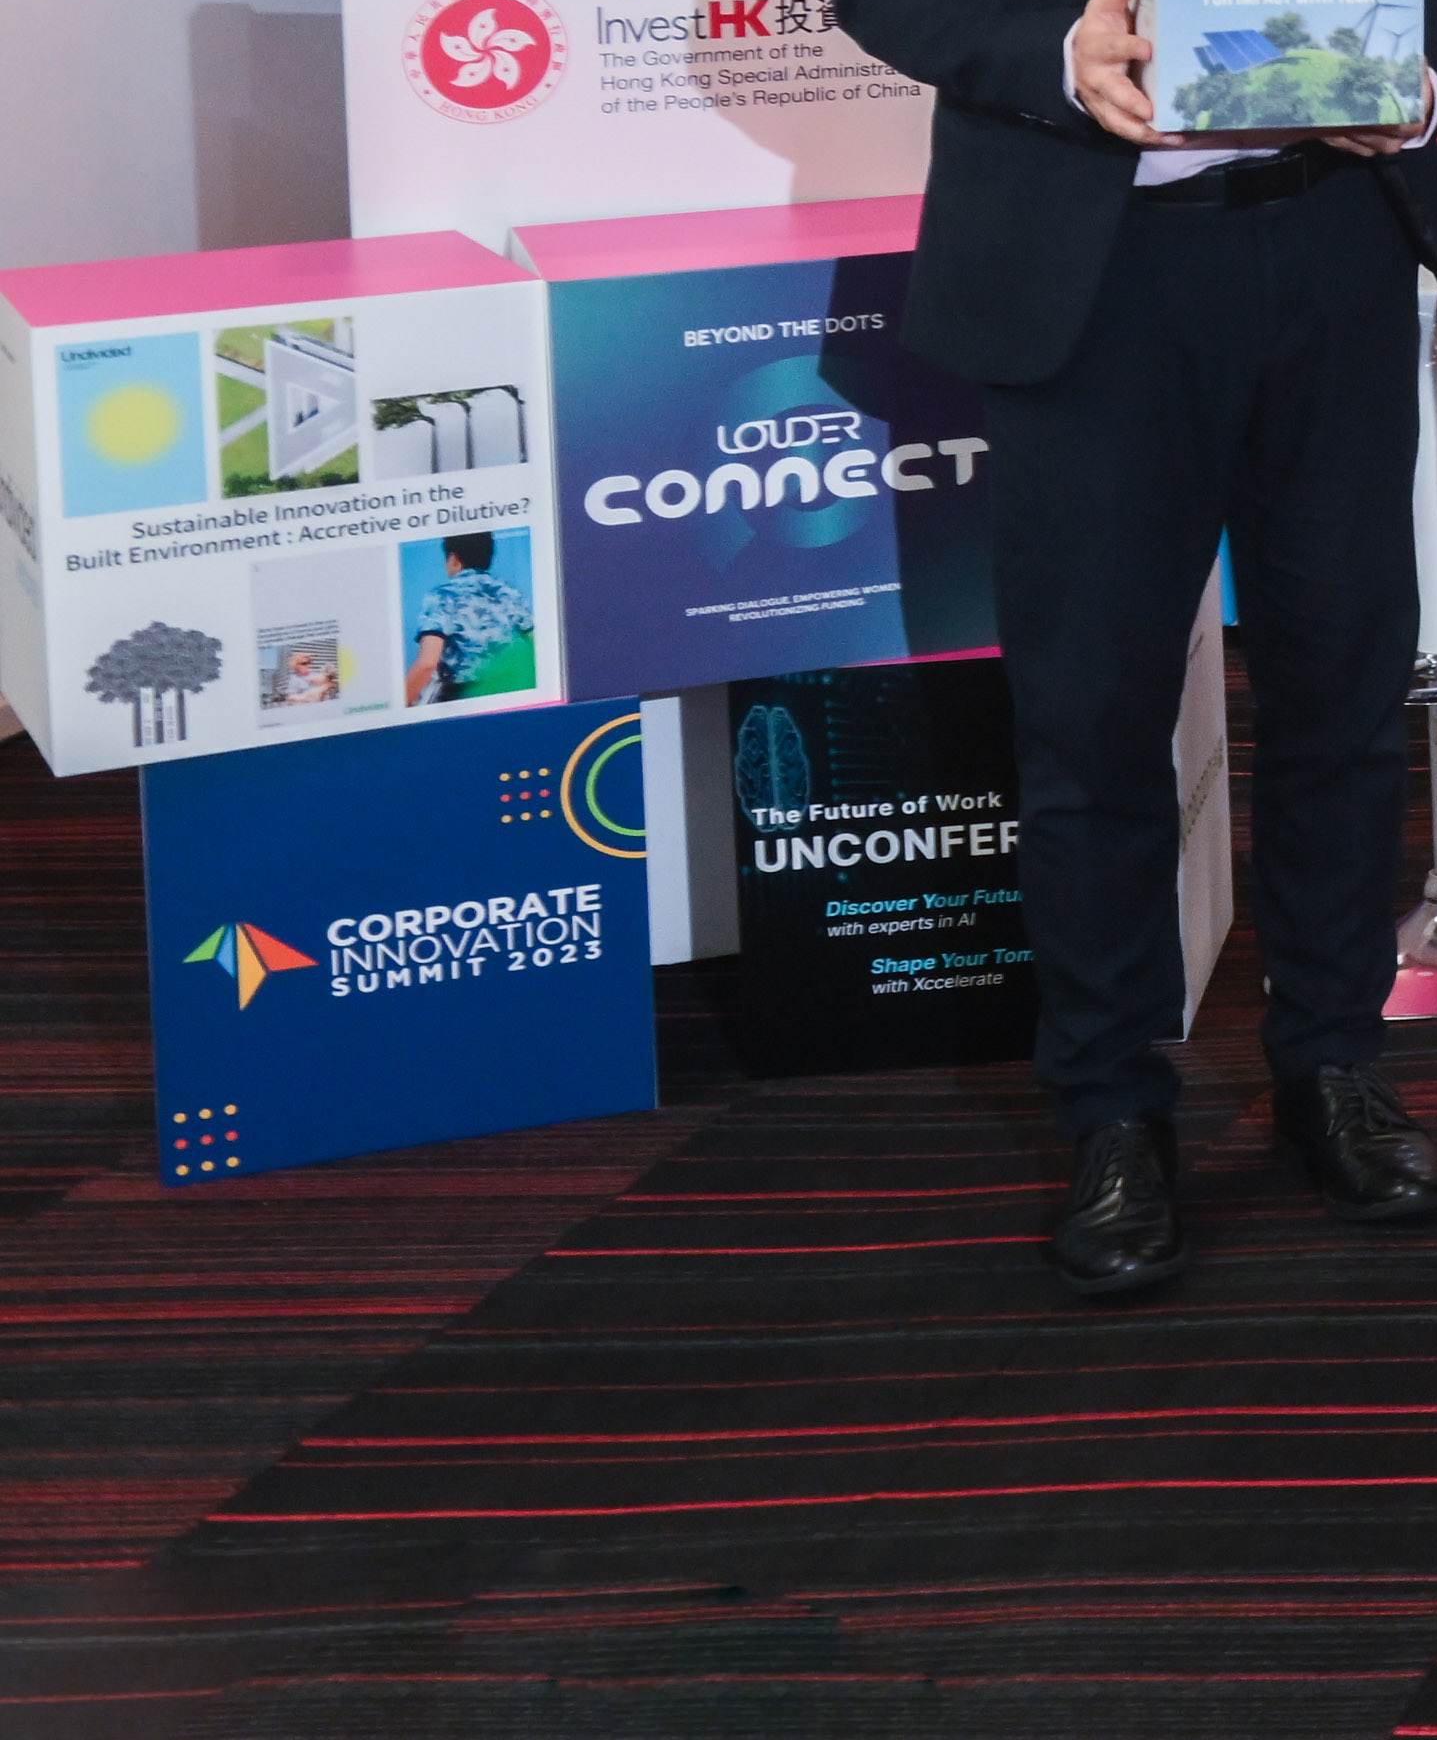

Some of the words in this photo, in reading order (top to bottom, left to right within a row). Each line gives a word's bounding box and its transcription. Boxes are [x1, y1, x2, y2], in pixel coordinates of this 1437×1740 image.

[600, 51, 635, 68] The
[643, 46, 763, 66] Government
[769, 45, 788, 59] of
[793, 44, 823, 58] the
[601, 76, 653, 93] Hong
[661, 73, 711, 90] Kong
[718, 66, 788, 87] Special
[601, 99, 621, 114] of
[627, 97, 657, 112] the
[665, 91, 746, 111] People's
[753, 86, 836, 108] Republic
[843, 84, 862, 100] of
[867, 82, 921, 99] China
[684, 323, 773, 347] BEYOND
[779, 319, 820, 337] THE
[825, 313, 884, 332] DOTS
[717, 411, 860, 454] LOUDER
[132, 507, 268, 542] Sustainable
[275, 492, 395, 521] Innovation
[402, 487, 423, 506] in
[428, 482, 464, 503] the
[66, 546, 123, 572] Built
[130, 530, 280, 565] Environment
[299, 515, 400, 544] Accretive
[407, 512, 431, 527] or
[437, 497, 531, 524] Dilutive?
[752, 807, 800, 825] The
[809, 799, 894, 821] Future
[902, 796, 927, 814] of
[936, 792, 1002, 812] Work
[327, 884, 601, 946] CORPORATE
[826, 897, 918, 917] Discover
[923, 894, 967, 909] Your
[828, 922, 863, 937] with
[868, 917, 934, 935] experts
[938, 915, 953, 928] in
[958, 913, 976, 926] AI
[331, 912, 600, 976] INNOVATION
[331, 957, 486, 997] SUMMIT
[507, 940, 601, 971] 2023
[871, 957, 935, 975] Shape
[942, 952, 986, 968] Your
[873, 979, 907, 994] with
[913, 973, 1003, 991] Xccelerate
